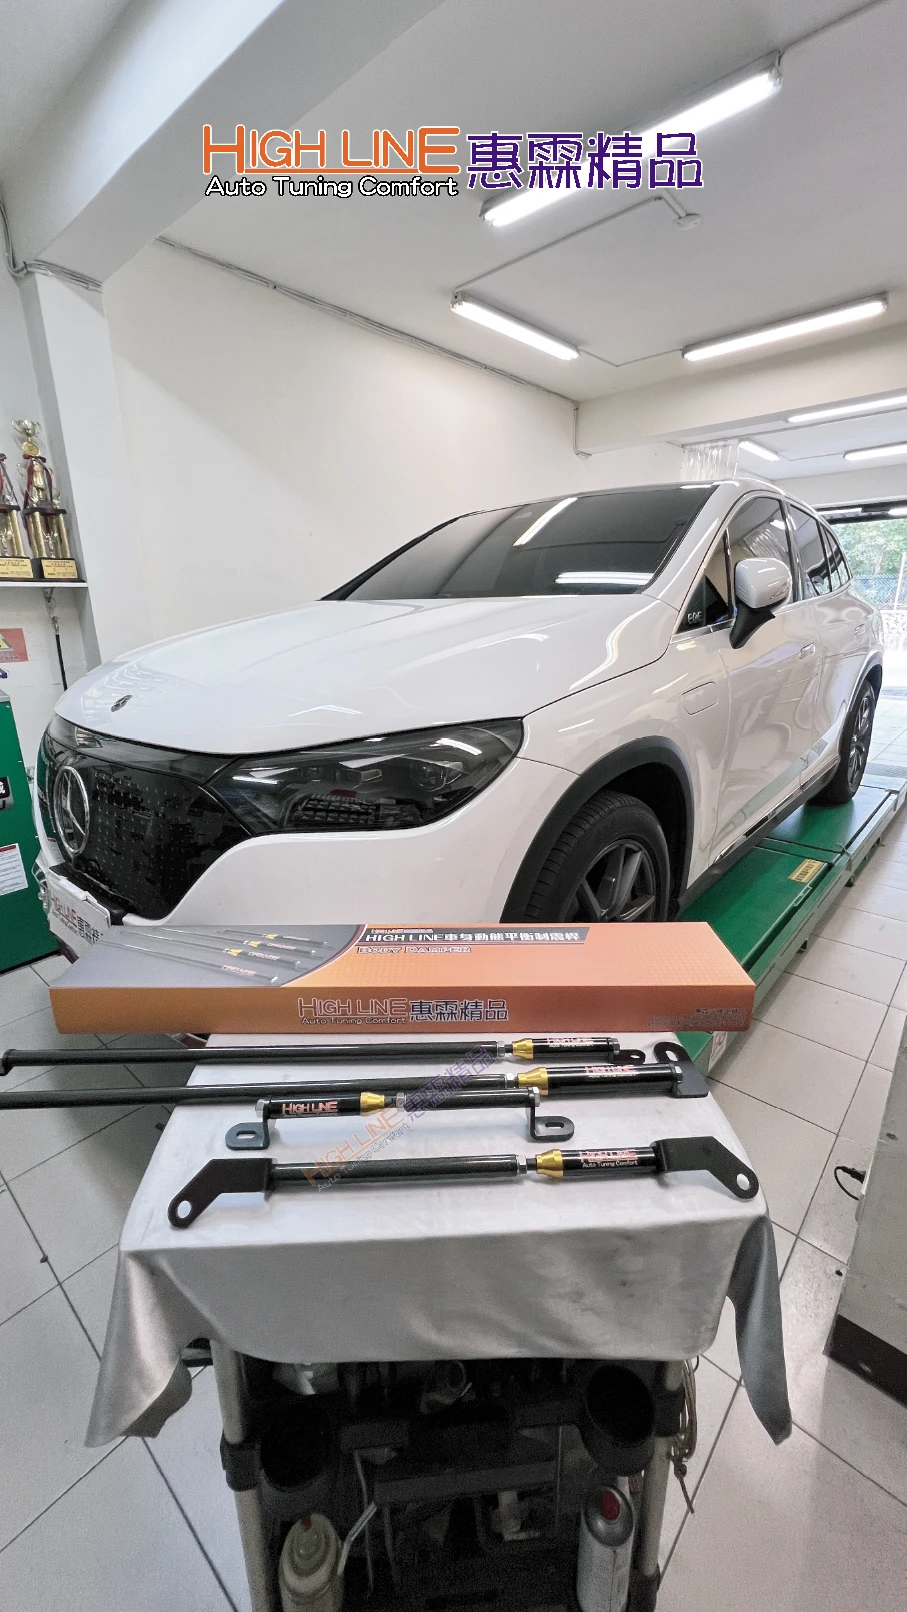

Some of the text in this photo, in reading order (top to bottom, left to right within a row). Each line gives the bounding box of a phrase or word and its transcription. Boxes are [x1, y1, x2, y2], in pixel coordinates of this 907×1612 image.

[366, 934, 408, 942] HIGH
[298, 997, 408, 1018] HIGH LINE
[409, 999, 509, 1022] 惠霖精品
[301, 1016, 406, 1025] Auto Tuning Comfort
[282, 1101, 339, 1115] HIGH LINE
